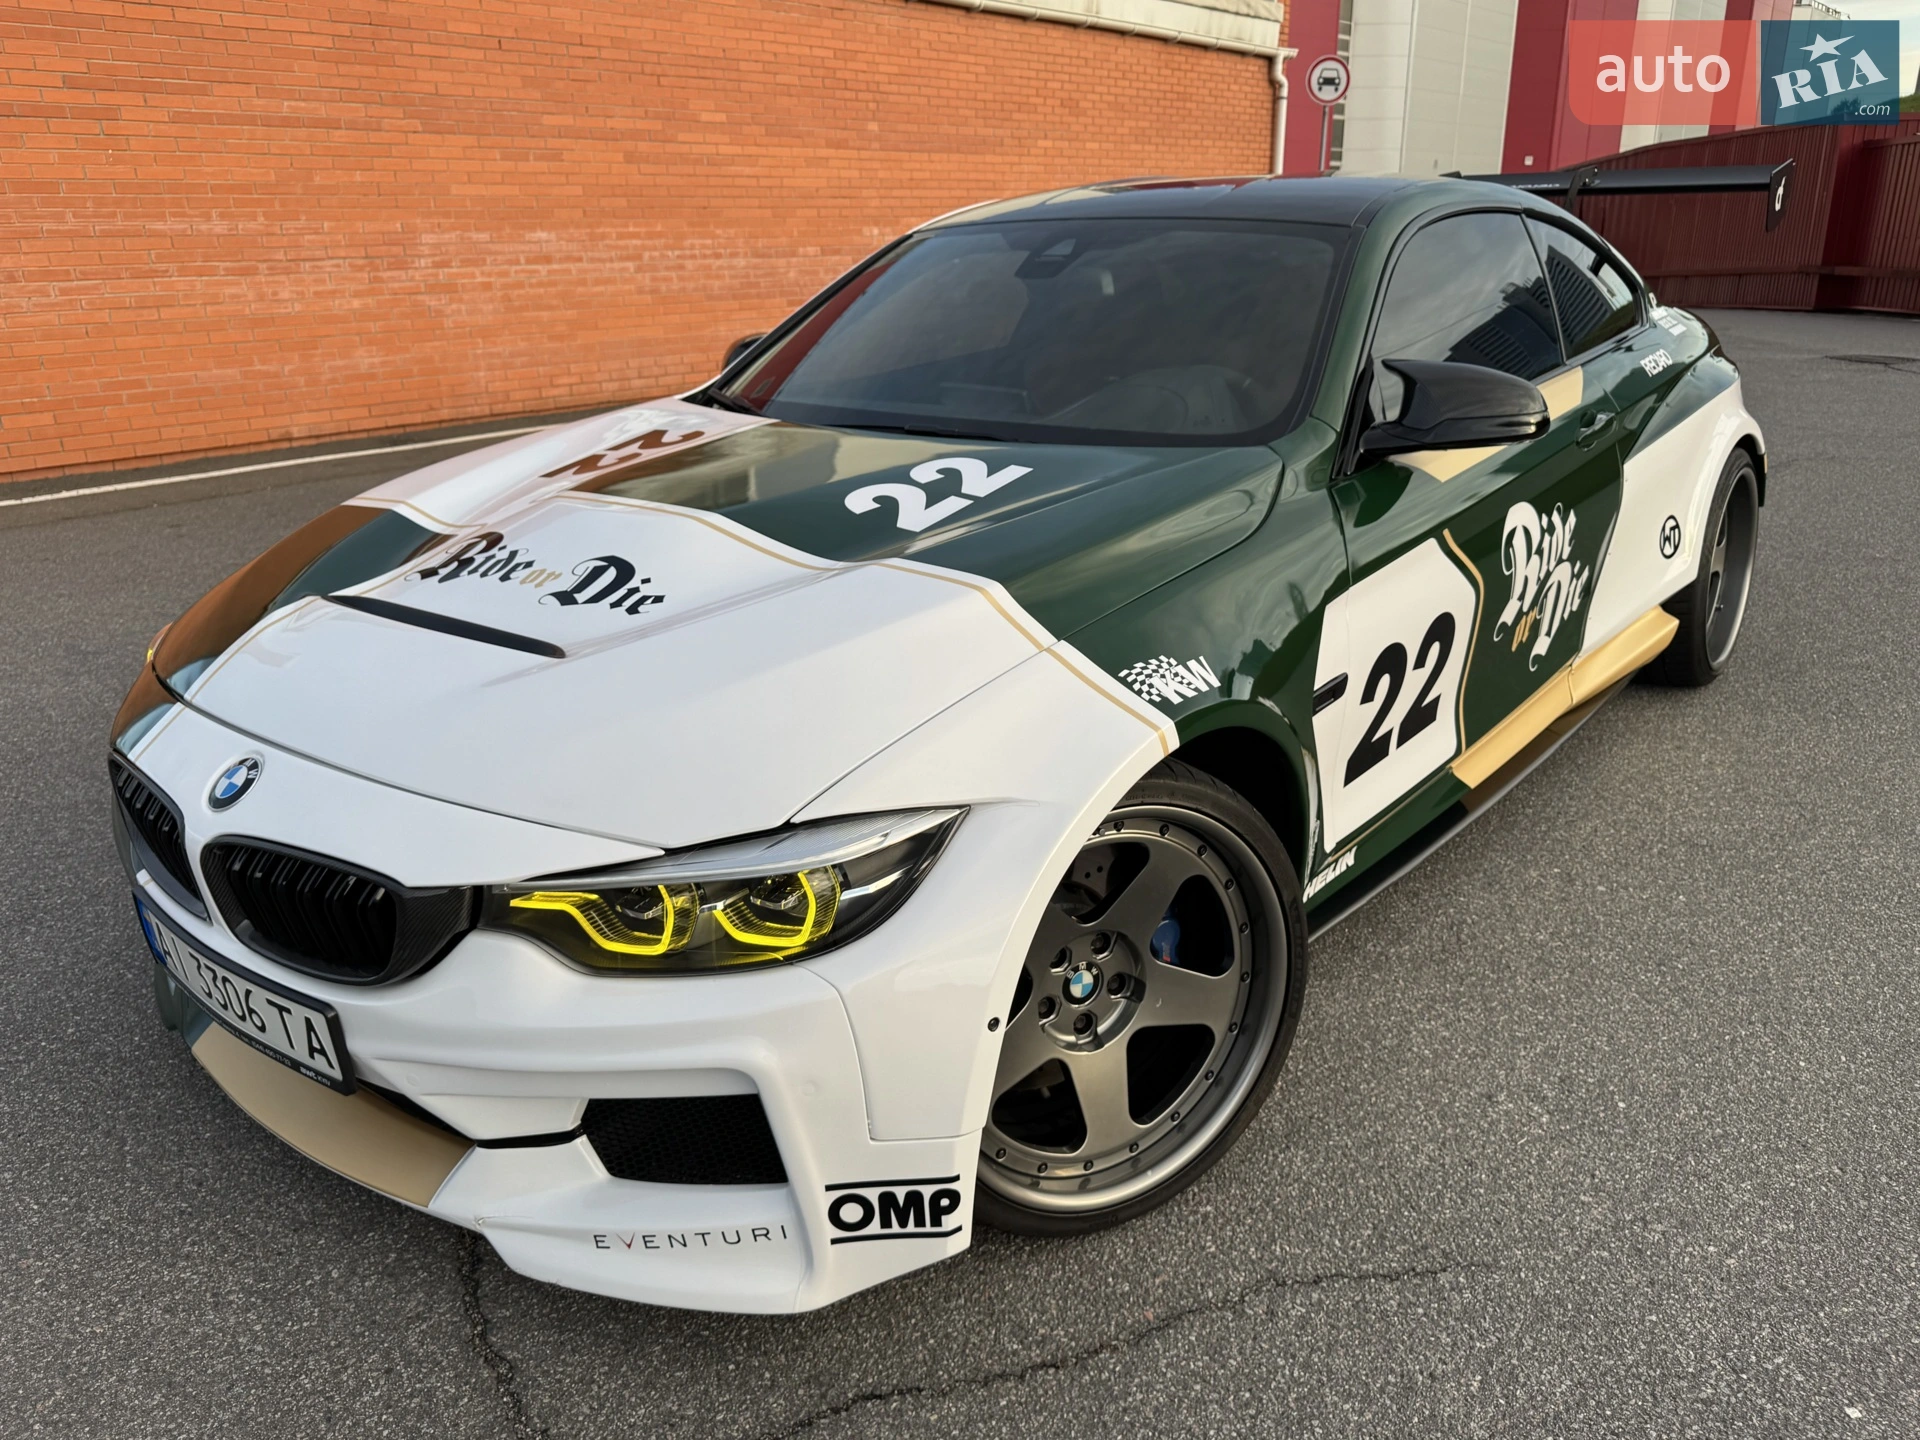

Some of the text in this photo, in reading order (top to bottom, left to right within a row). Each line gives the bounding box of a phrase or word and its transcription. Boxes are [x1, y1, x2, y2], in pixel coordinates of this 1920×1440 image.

[1640, 348, 1673, 378] RECARO
[538, 429, 706, 479] 22
[844, 457, 1034, 533] 22
[403, 531, 666, 616] Ride or Die
[1493, 501, 1577, 642] Ride
[1511, 560, 1589, 672] or Die
[1147, 655, 1222, 706] KW
[1343, 611, 1456, 789] 22
[154, 921, 190, 982] AI
[187, 950, 267, 1034] 3306
[265, 997, 336, 1071] TA
[1066, 961, 1099, 980] BMW
[593, 1224, 788, 1250] EVENTURI
[827, 1188, 962, 1232] OMP
